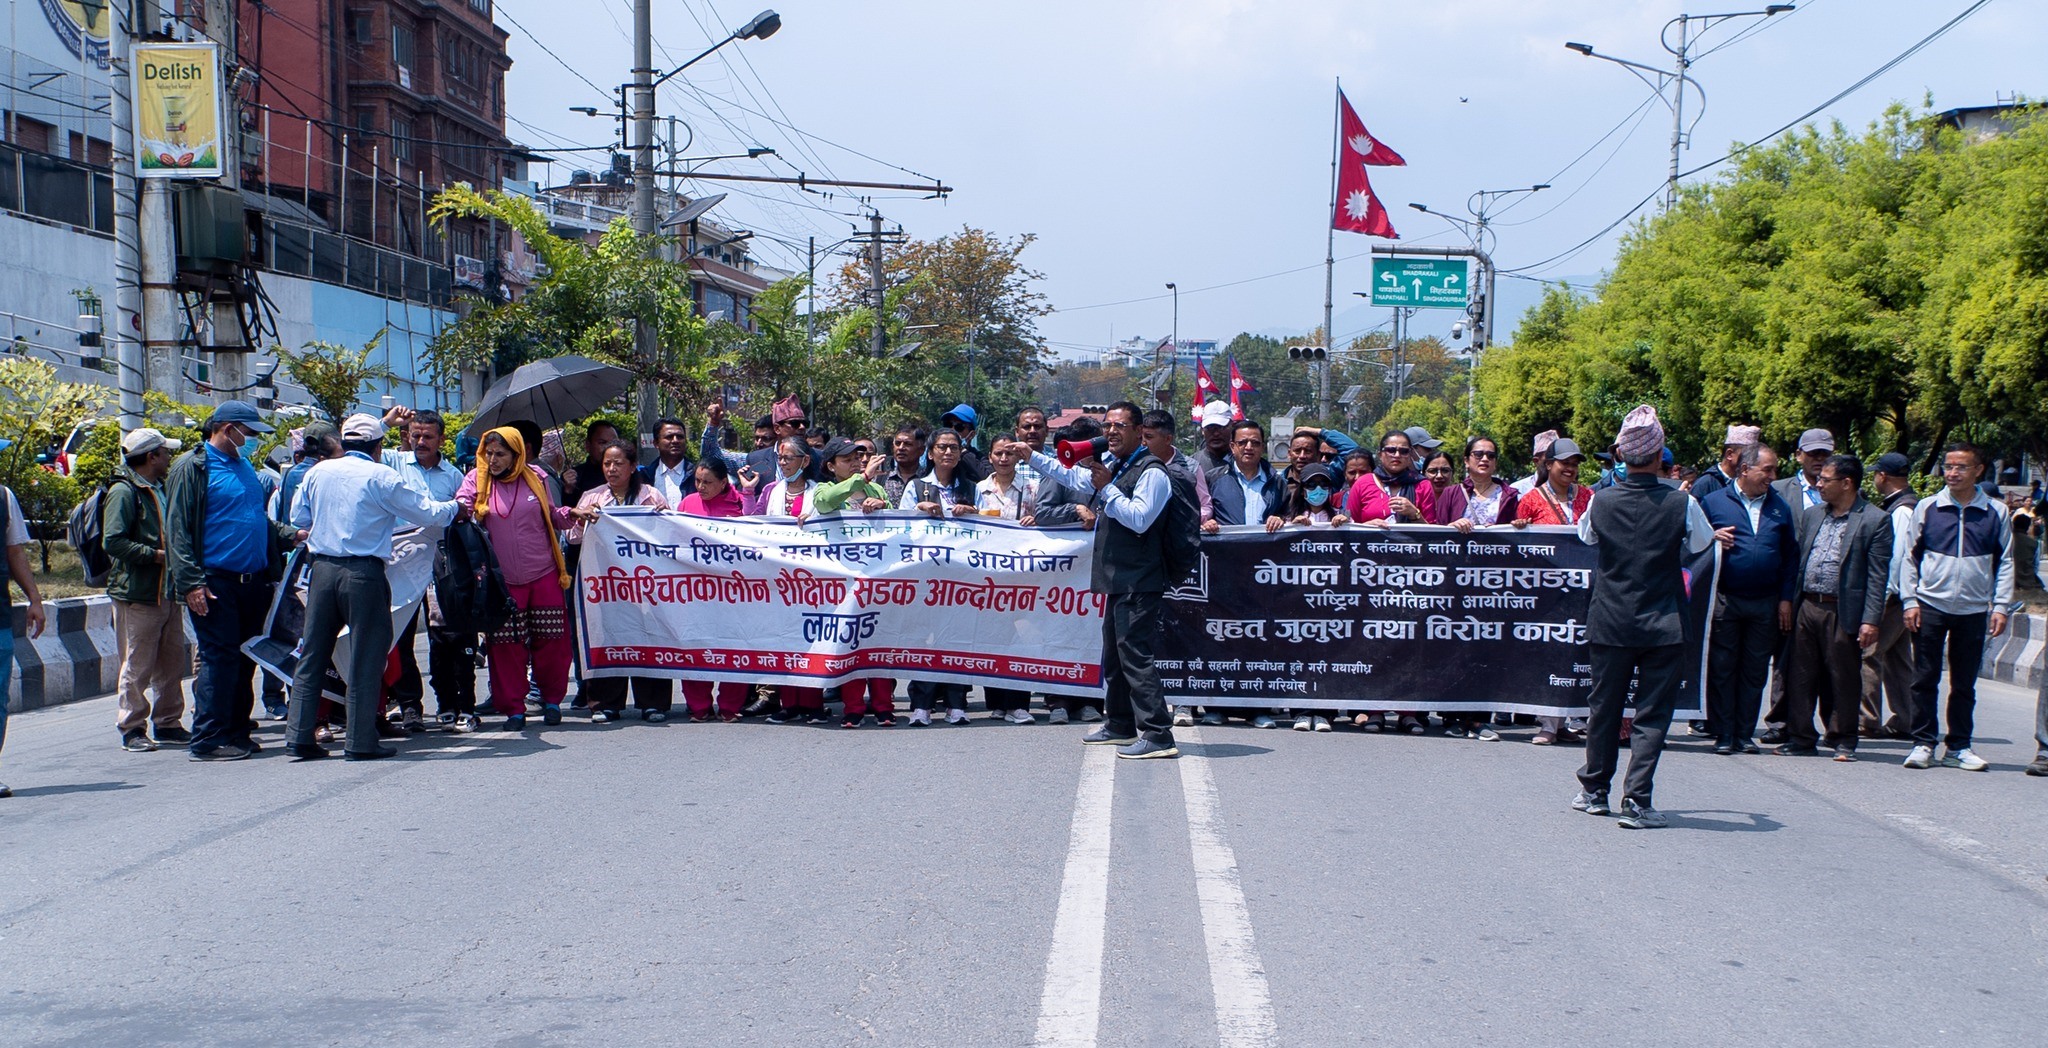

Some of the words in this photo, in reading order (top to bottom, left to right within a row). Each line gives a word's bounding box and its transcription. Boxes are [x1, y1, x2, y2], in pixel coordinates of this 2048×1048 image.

[144, 63, 201, 80] Delish
[840, 522, 874, 537] मेरो
[615, 535, 680, 561] नेपाल
[690, 536, 767, 564] शिक्षक
[900, 543, 955, 566] द्वारा
[967, 549, 1078, 573] आयोजित
[1289, 538, 1343, 554] अधिकार
[1349, 543, 1360, 554] र
[1367, 539, 1422, 555] कर्तव्यका
[1428, 540, 1460, 555] लागि
[1467, 540, 1511, 556] शिक्षक
[1517, 544, 1555, 558] एकता
[1254, 559, 1341, 586] नेपाल
[1350, 558, 1446, 588] शिक्षक
[1455, 566, 1592, 593] महासङ्घ
[584, 565, 771, 606] अनिश्चितकालीन
[774, 568, 848, 609] शैक्षिक
[853, 577, 919, 609] सडक
[1304, 589, 1361, 611] राष्ट्रिय
[1368, 589, 1454, 611] समितिद्वारा
[1463, 591, 1538, 610] आयोजित
[802, 612, 880, 650] लमजुङ
[1206, 618, 1267, 642] बृहत्
[1274, 618, 1354, 643] जुलुश
[1362, 618, 1417, 640] तथा
[1426, 615, 1505, 641] विरोध
[655, 651, 694, 664] २०८१
[702, 649, 726, 666] चैत्र
[732, 654, 750, 667] २०
[758, 652, 778, 668] गते
[784, 653, 809, 669] देखि
[868, 649, 935, 668] माईतीघर
[941, 654, 999, 673] मण्डला,
[1208, 658, 1242, 672] सहमती
[1290, 660, 1303, 676] हुने
[1308, 661, 1327, 674] गरी
[1188, 676, 1215, 690] शिक्षा
[1220, 677, 1235, 691] ऐन
[1239, 677, 1264, 691] जारी
[1268, 678, 1307, 693] गरियोस्
[1549, 674, 1577, 687] जिल्ला
